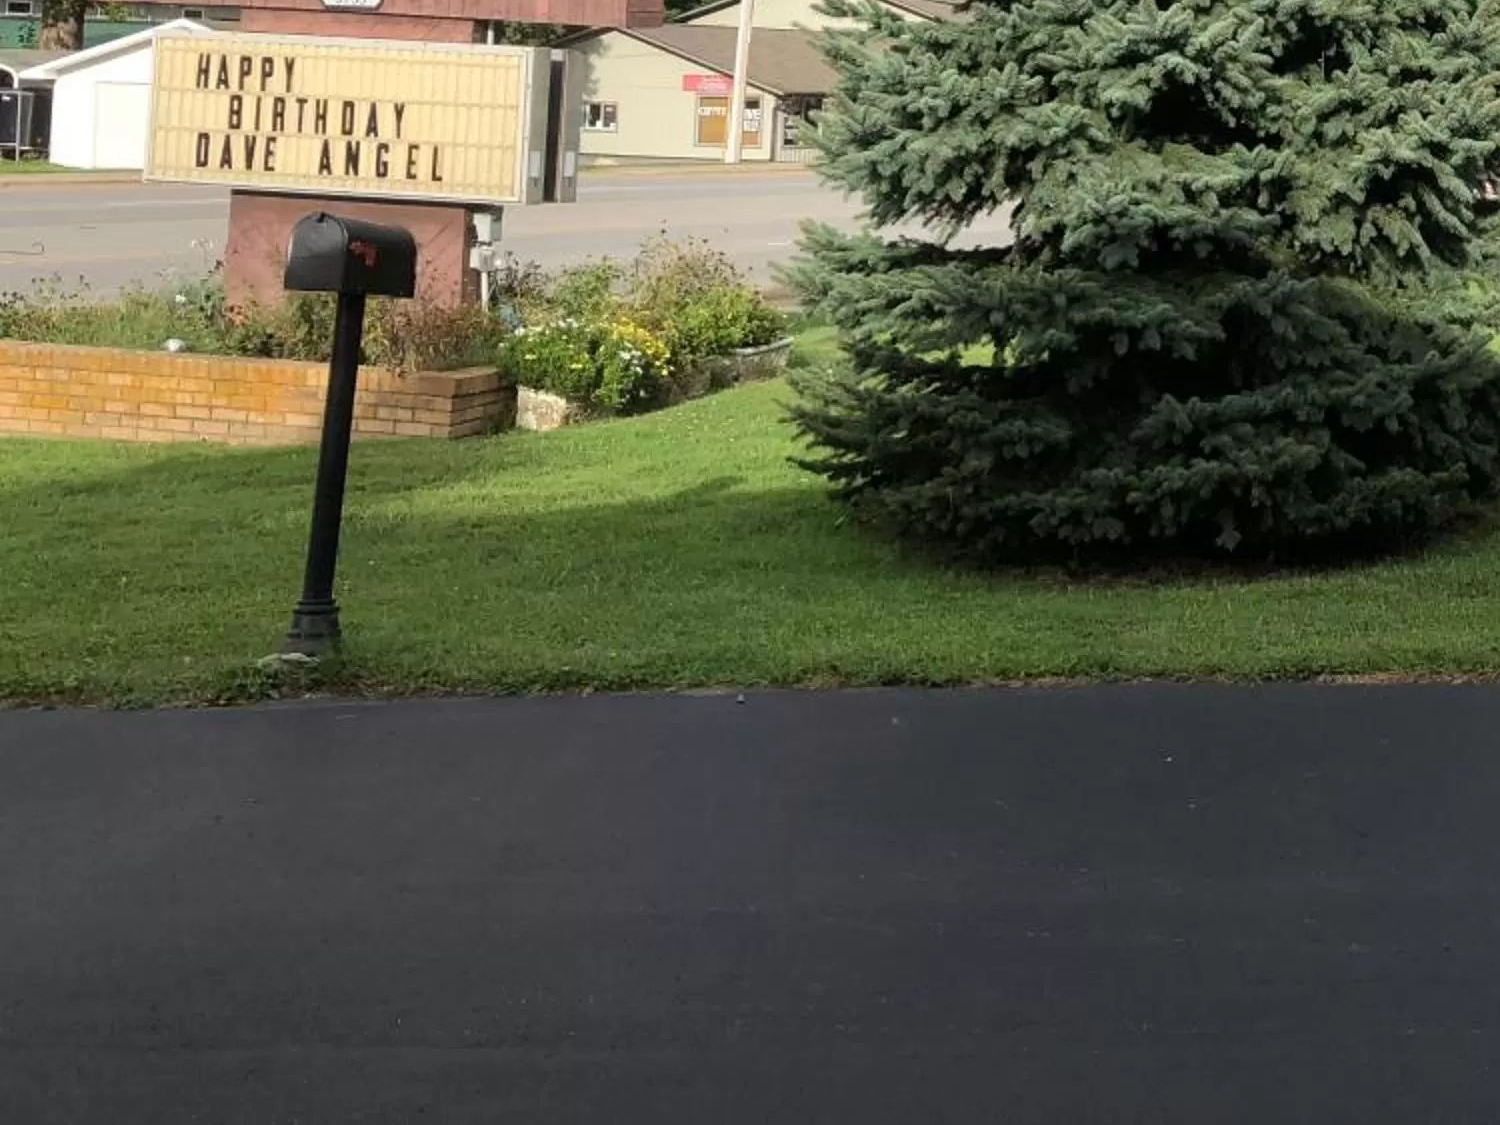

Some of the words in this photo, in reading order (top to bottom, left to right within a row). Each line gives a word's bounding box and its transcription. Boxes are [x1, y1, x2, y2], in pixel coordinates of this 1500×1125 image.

[195, 52, 296, 91] HAPPY
[228, 95, 406, 140] BIRTHDAY
[195, 133, 277, 172] DAVE
[318, 140, 443, 182] ANGEL
